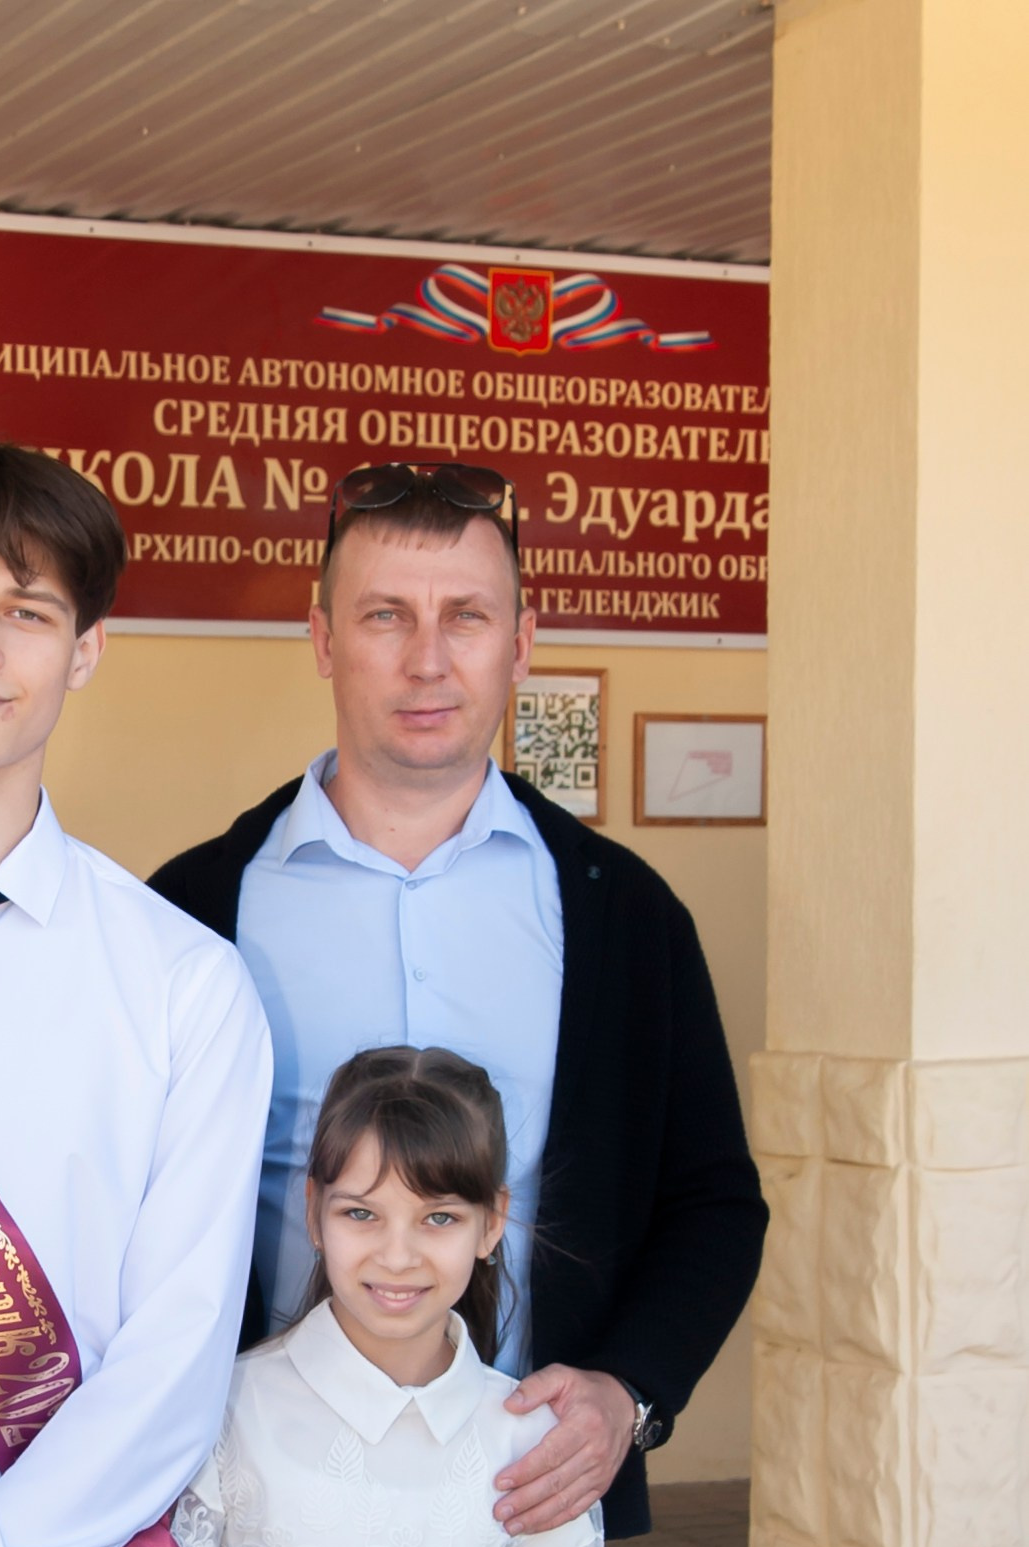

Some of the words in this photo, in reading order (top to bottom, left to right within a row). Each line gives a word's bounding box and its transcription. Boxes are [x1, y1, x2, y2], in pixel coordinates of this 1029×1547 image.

[237, 356, 466, 398] АВТОНОМНОЕ
[153, 398, 348, 447] СРЕДНЯЯ
[263, 456, 328, 511] №
[540, 587, 721, 623] ГЕЛЕНДЖИК
